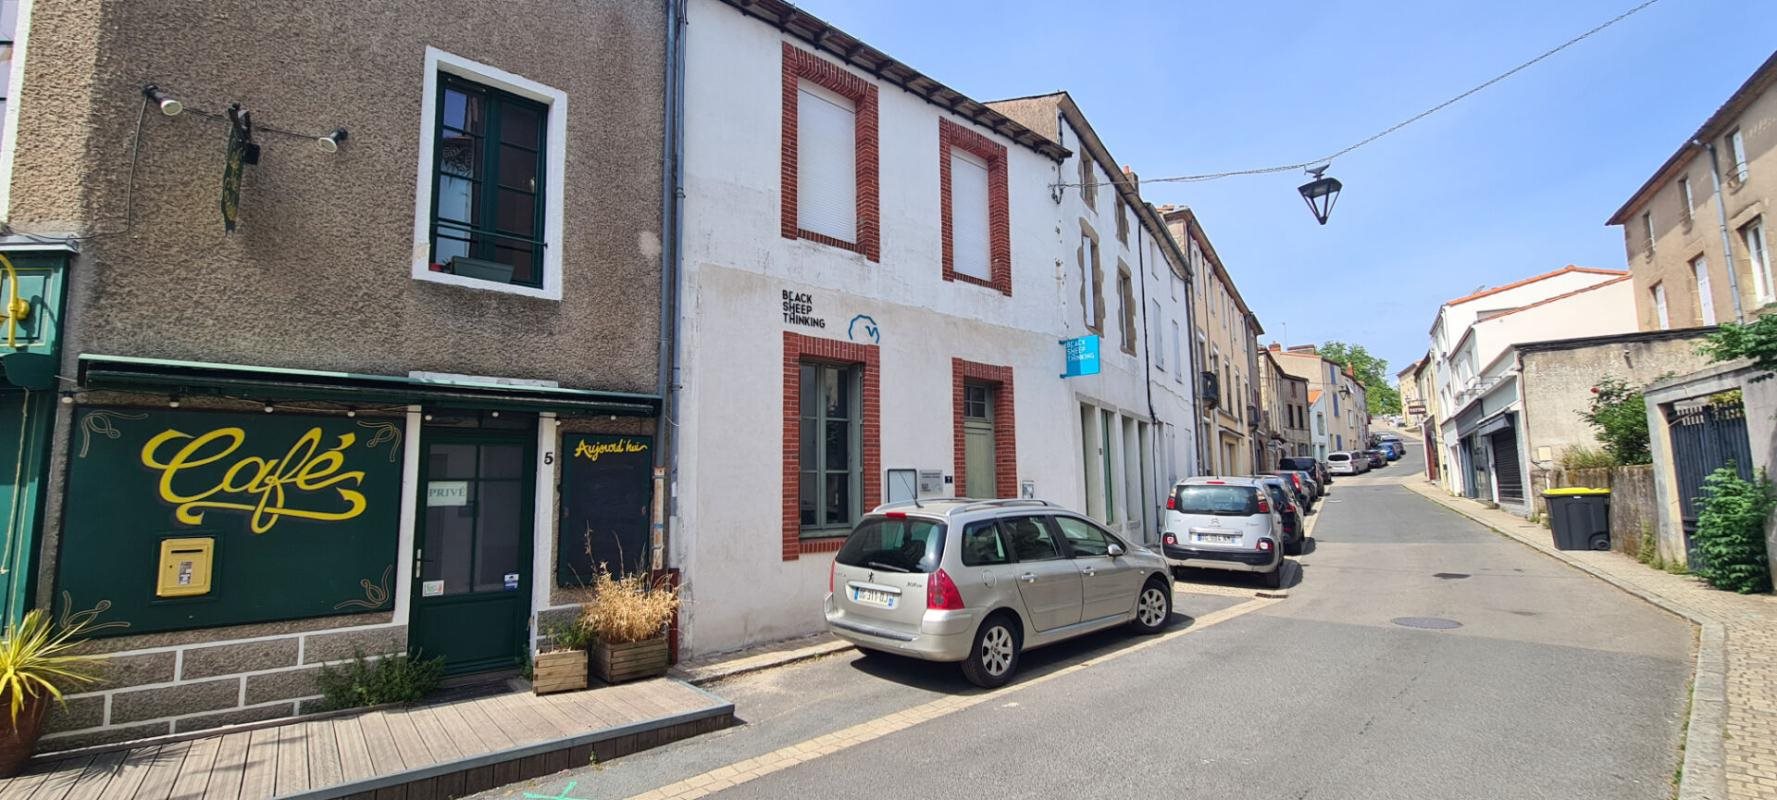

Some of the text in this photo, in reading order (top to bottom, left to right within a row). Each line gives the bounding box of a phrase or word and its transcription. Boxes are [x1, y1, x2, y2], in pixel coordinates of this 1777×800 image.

[782, 289, 813, 304] BLACK
[783, 301, 813, 315] SHEEP
[783, 312, 826, 328] THINKING
[544, 452, 554, 465] 5
[141, 427, 367, 534] Café
[428, 486, 467, 498] PRIVÉ
